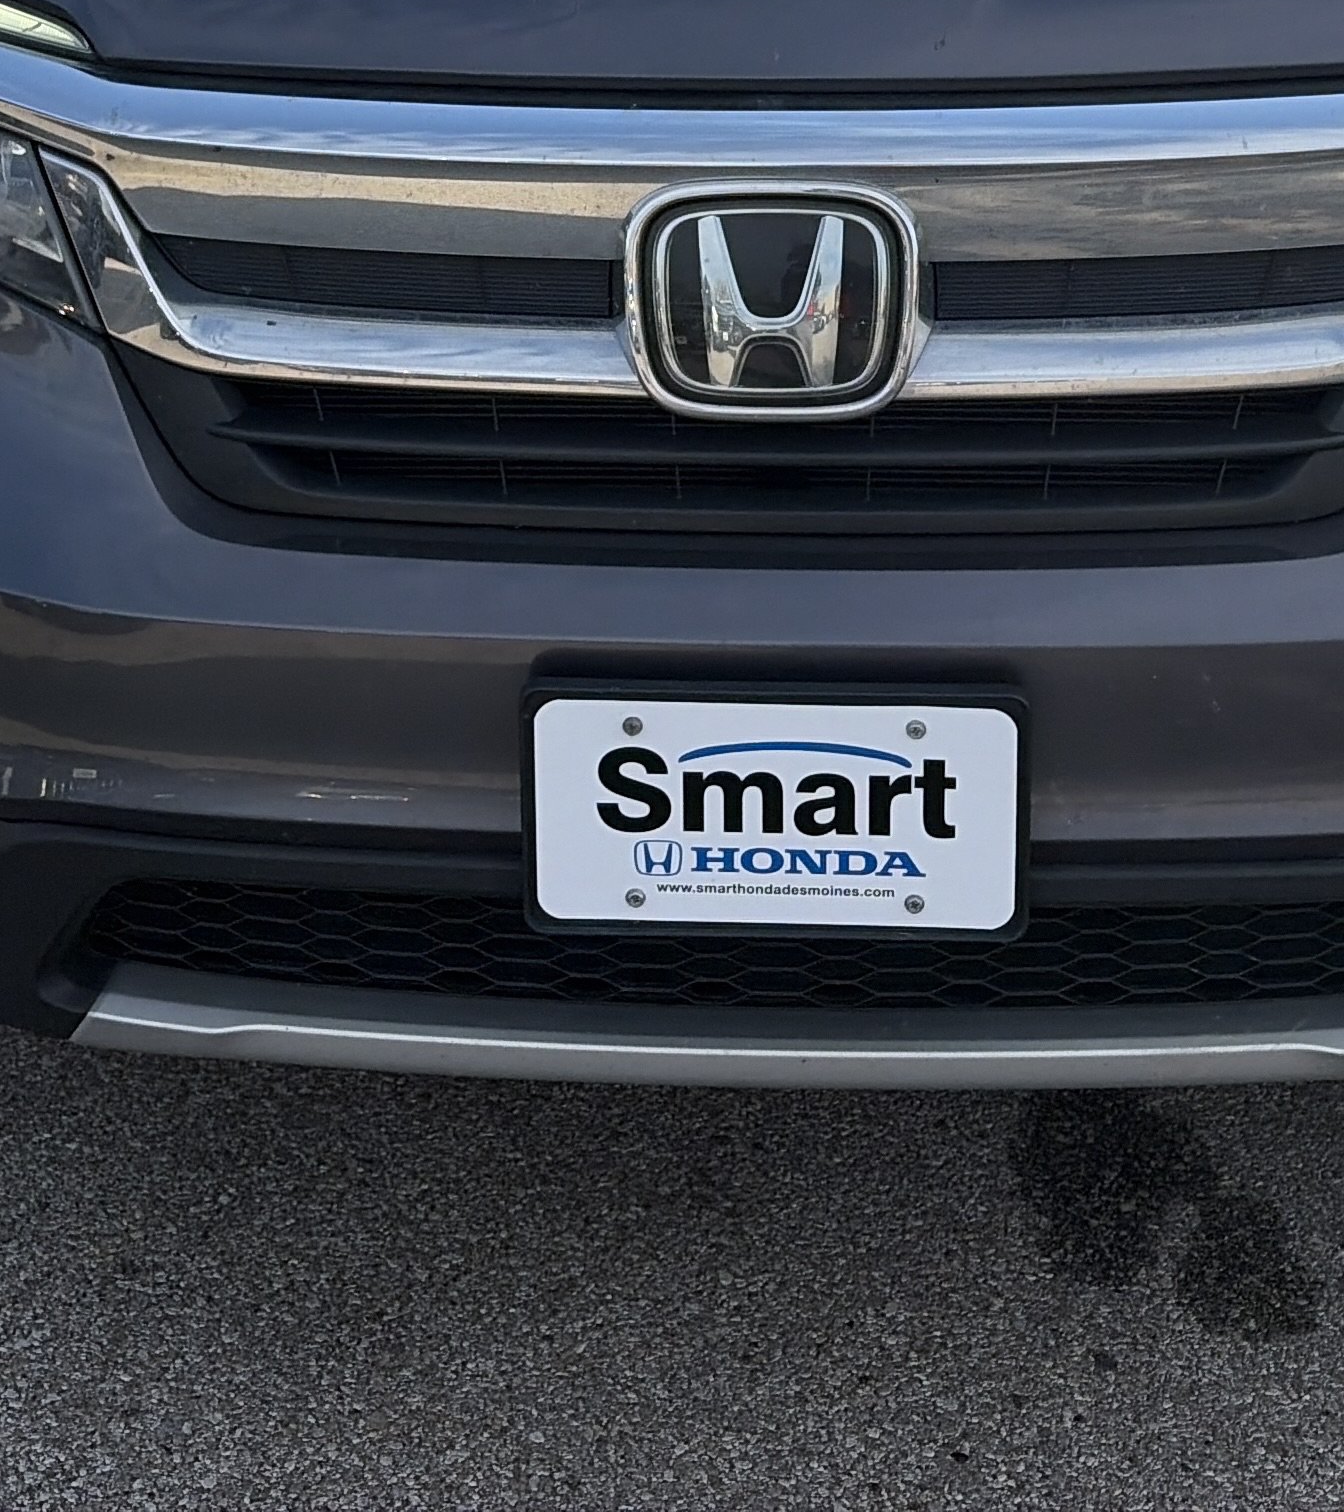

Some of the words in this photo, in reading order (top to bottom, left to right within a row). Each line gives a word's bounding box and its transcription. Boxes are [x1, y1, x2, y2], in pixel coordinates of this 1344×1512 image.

[596, 746, 956, 839] Smart
[690, 846, 926, 878] HONDA
[656, 883, 896, 899] www.smarthondadesmoines.com
